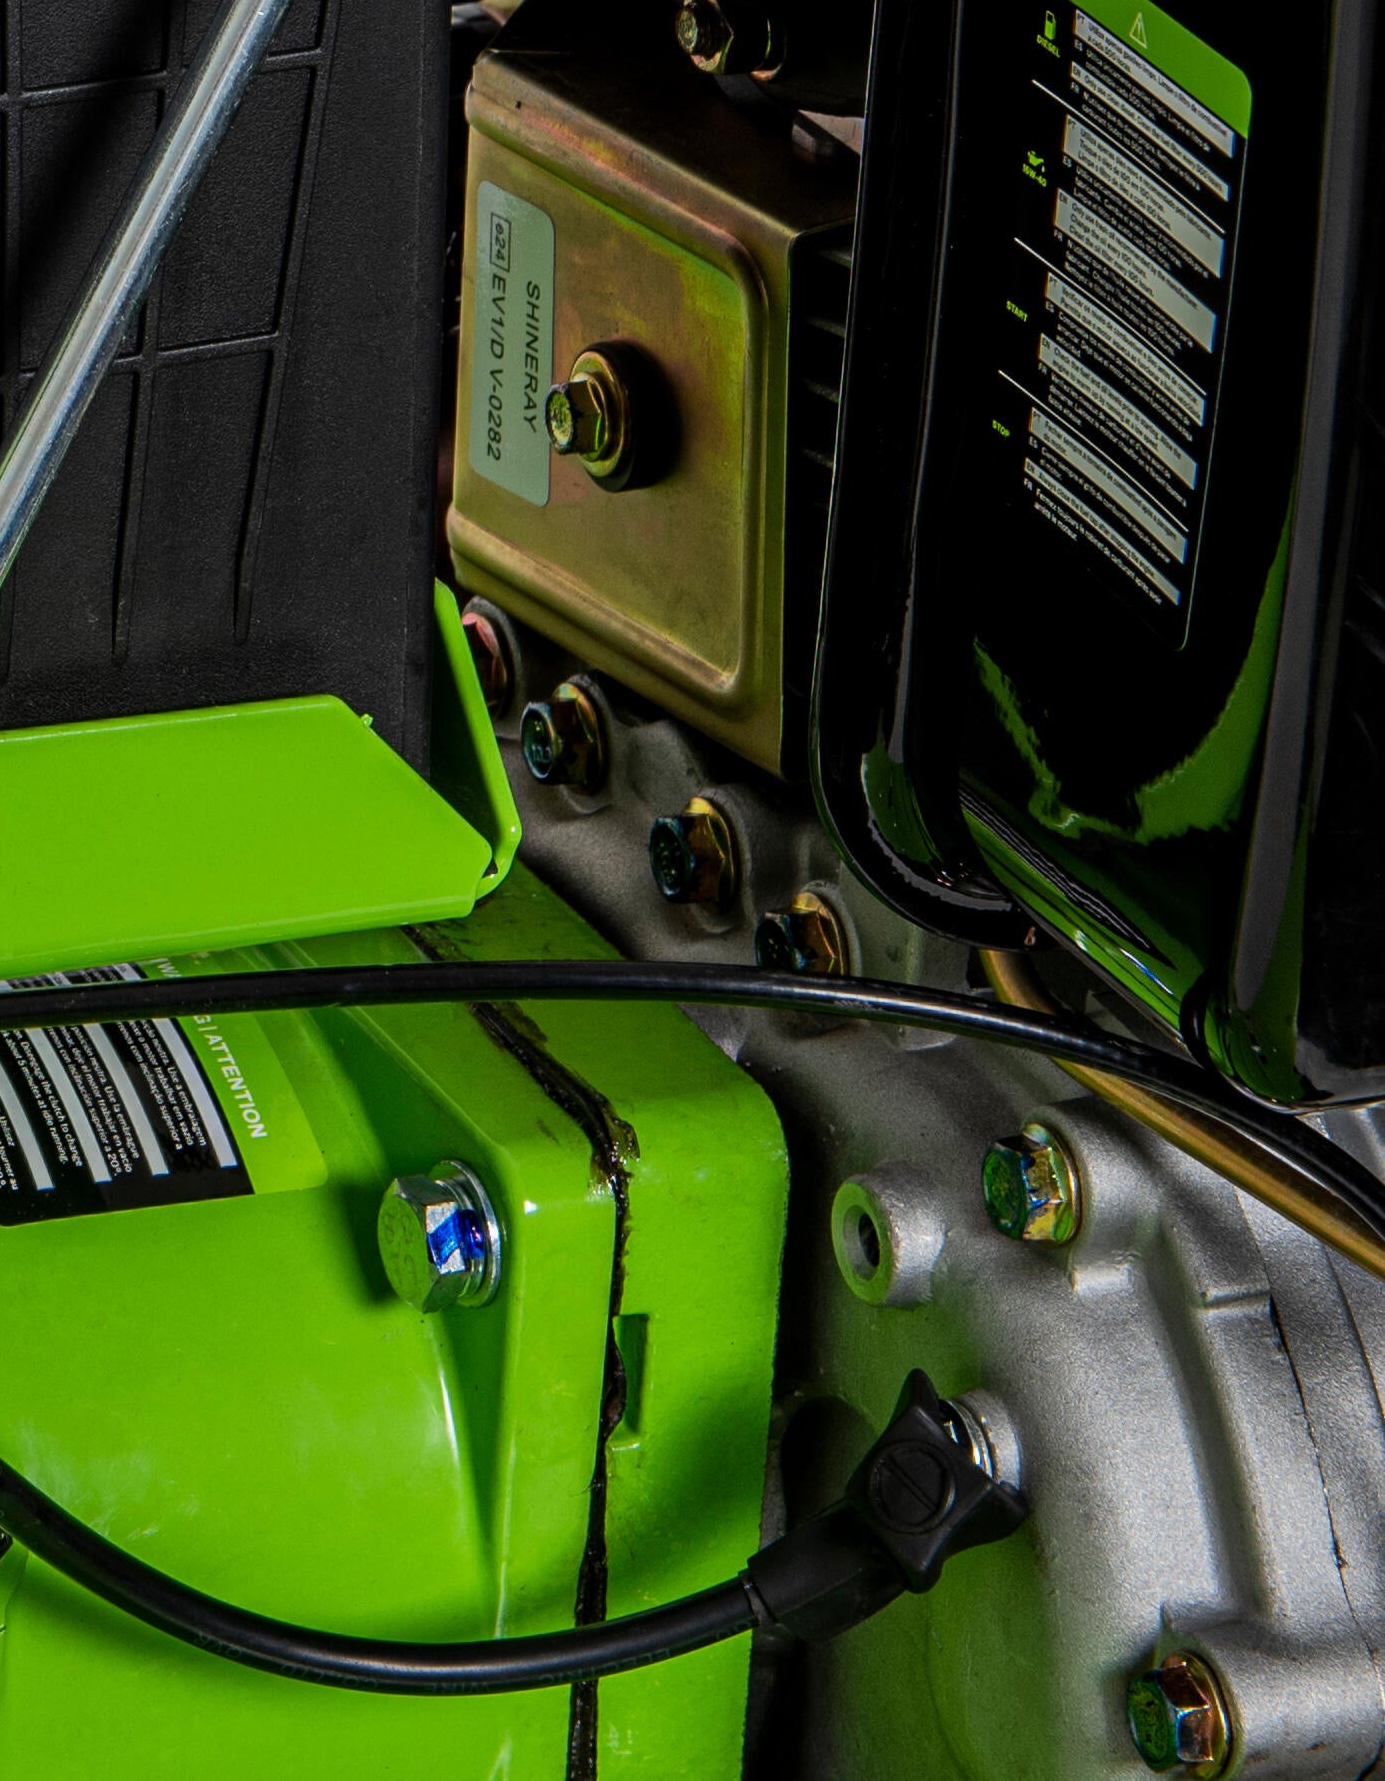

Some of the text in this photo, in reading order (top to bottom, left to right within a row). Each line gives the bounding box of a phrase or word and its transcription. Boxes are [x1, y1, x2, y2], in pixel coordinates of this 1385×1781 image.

[490, 273, 507, 361] EV1/D
[522, 279, 541, 435] SHINERAY
[486, 368, 504, 462] V-0282
[992, 419, 1011, 438] STOP
[203, 1034, 268, 1140] ATTENTION
